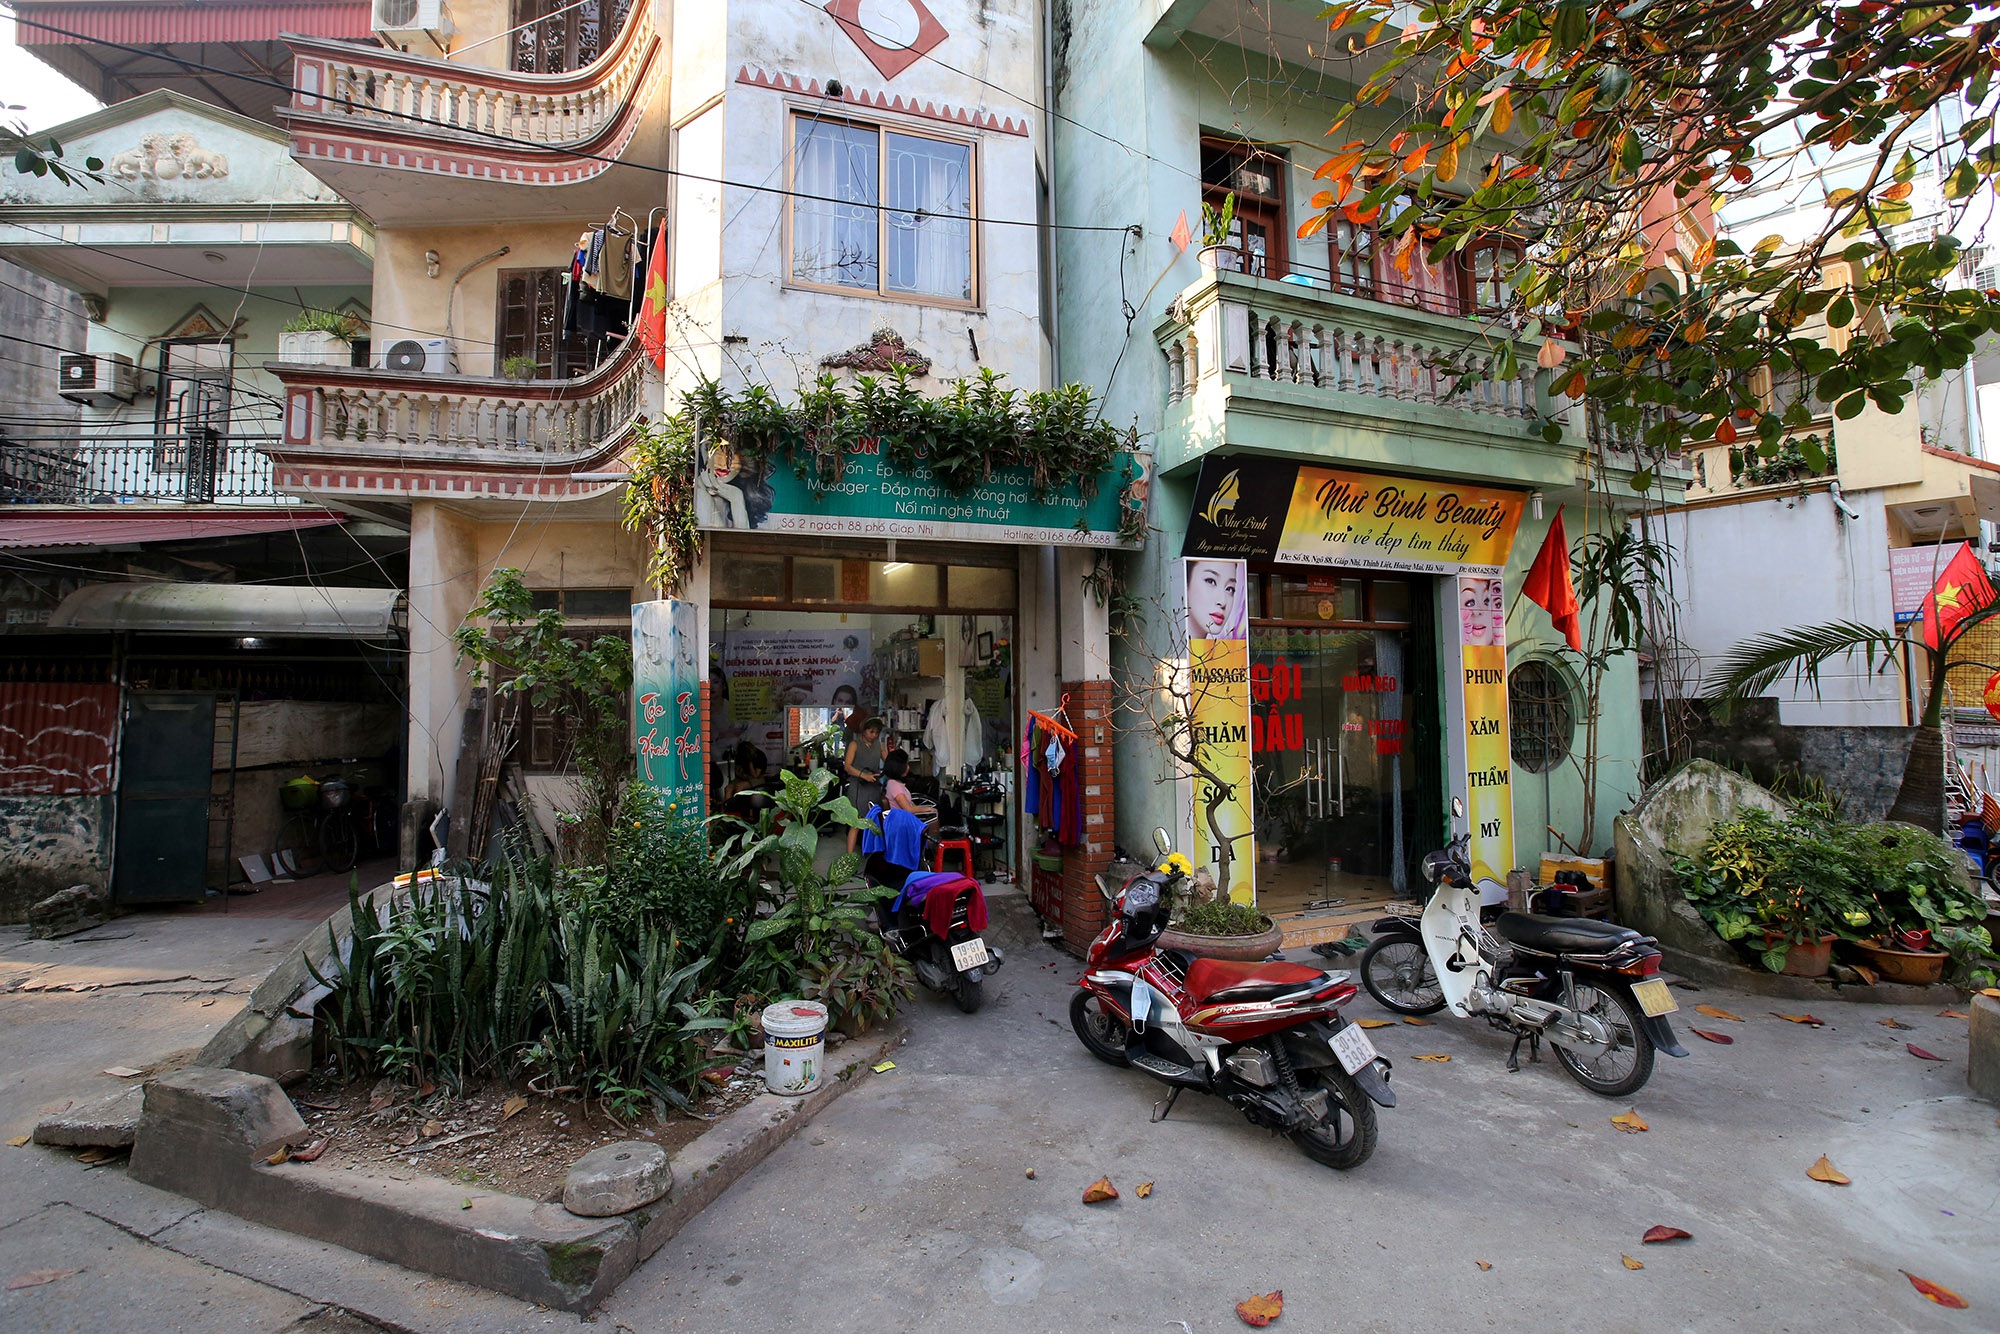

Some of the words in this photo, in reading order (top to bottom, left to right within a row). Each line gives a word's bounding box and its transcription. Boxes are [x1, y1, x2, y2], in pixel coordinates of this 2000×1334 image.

[876, 463, 893, 478] Ép
[1003, 473, 1024, 486] tóc
[881, 482, 910, 498] Đắp
[914, 485, 941, 500] mặt
[972, 488, 1005, 505] Xông
[1009, 491, 1028, 504] hơi
[895, 501, 917, 514] Nối
[921, 505, 936, 515] mi
[940, 505, 973, 519] nghệ
[977, 506, 1011, 521] thuật
[1315, 478, 1369, 520] Như
[1373, 486, 1429, 520] Bình
[1434, 493, 1507, 541] Beauty
[781, 517, 795, 529] Số
[798, 519, 805, 529] 2
[810, 520, 844, 531] ngách
[848, 521, 861, 531] 88
[865, 522, 886, 533] phố
[889, 523, 915, 535] Giáp
[918, 525, 934, 536] Nhị
[1003, 529, 1037, 540] Hotline:
[1039, 531, 1064, 541] 0168
[1353, 528, 1373, 545] vẻ
[1375, 522, 1403, 555] đẹp
[1408, 532, 1433, 550] tìm
[1437, 528, 1471, 561] thấy
[1191, 667, 1246, 683] MASSAGE
[1250, 656, 1302, 707] GỘI
[1342, 668, 1372, 692] GIẢM
[1375, 672, 1397, 692] BÉO
[1465, 669, 1503, 684] PHUN
[640, 692, 666, 724] Tóc
[676, 692, 697, 724] Tóc
[1194, 721, 1246, 744] CHĂM
[1367, 719, 1408, 736] TATTOO
[1470, 717, 1500, 736] XĂM
[1468, 766, 1509, 787] THẨM
[1480, 818, 1501, 838] MỸ
[957, 951, 986, 969] 193.00
[775, 1035, 818, 1047] MAXILITE
[1345, 1043, 1372, 1069] 3983
